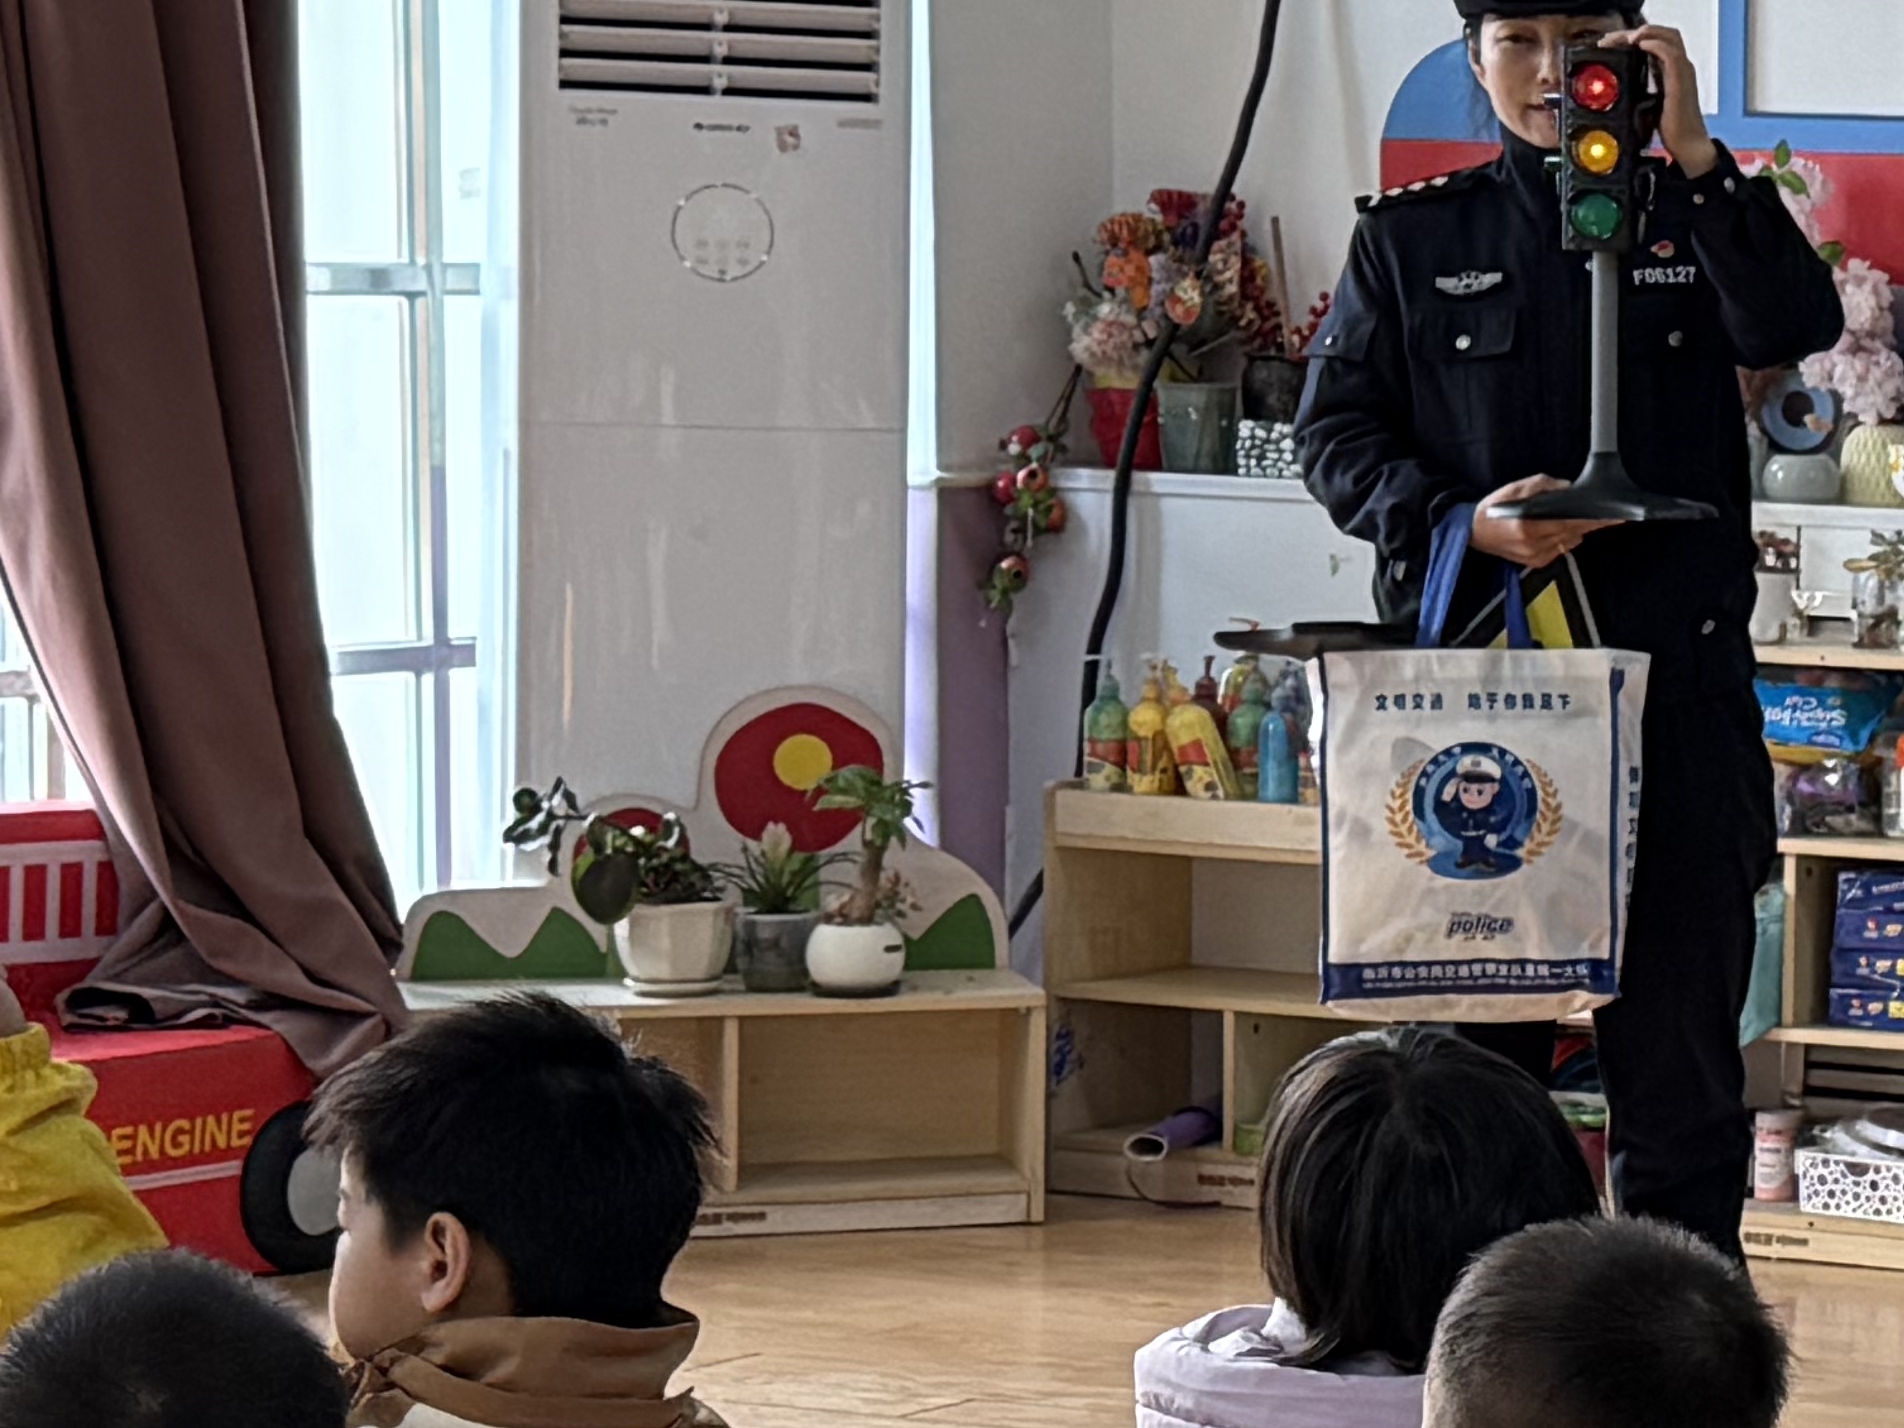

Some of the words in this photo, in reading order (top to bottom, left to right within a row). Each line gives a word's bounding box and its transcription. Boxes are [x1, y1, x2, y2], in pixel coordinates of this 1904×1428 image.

[1374, 692, 1443, 711] 文明交通
[1446, 915, 1515, 939] police
[116, 1109, 256, 1165] ENGINE
